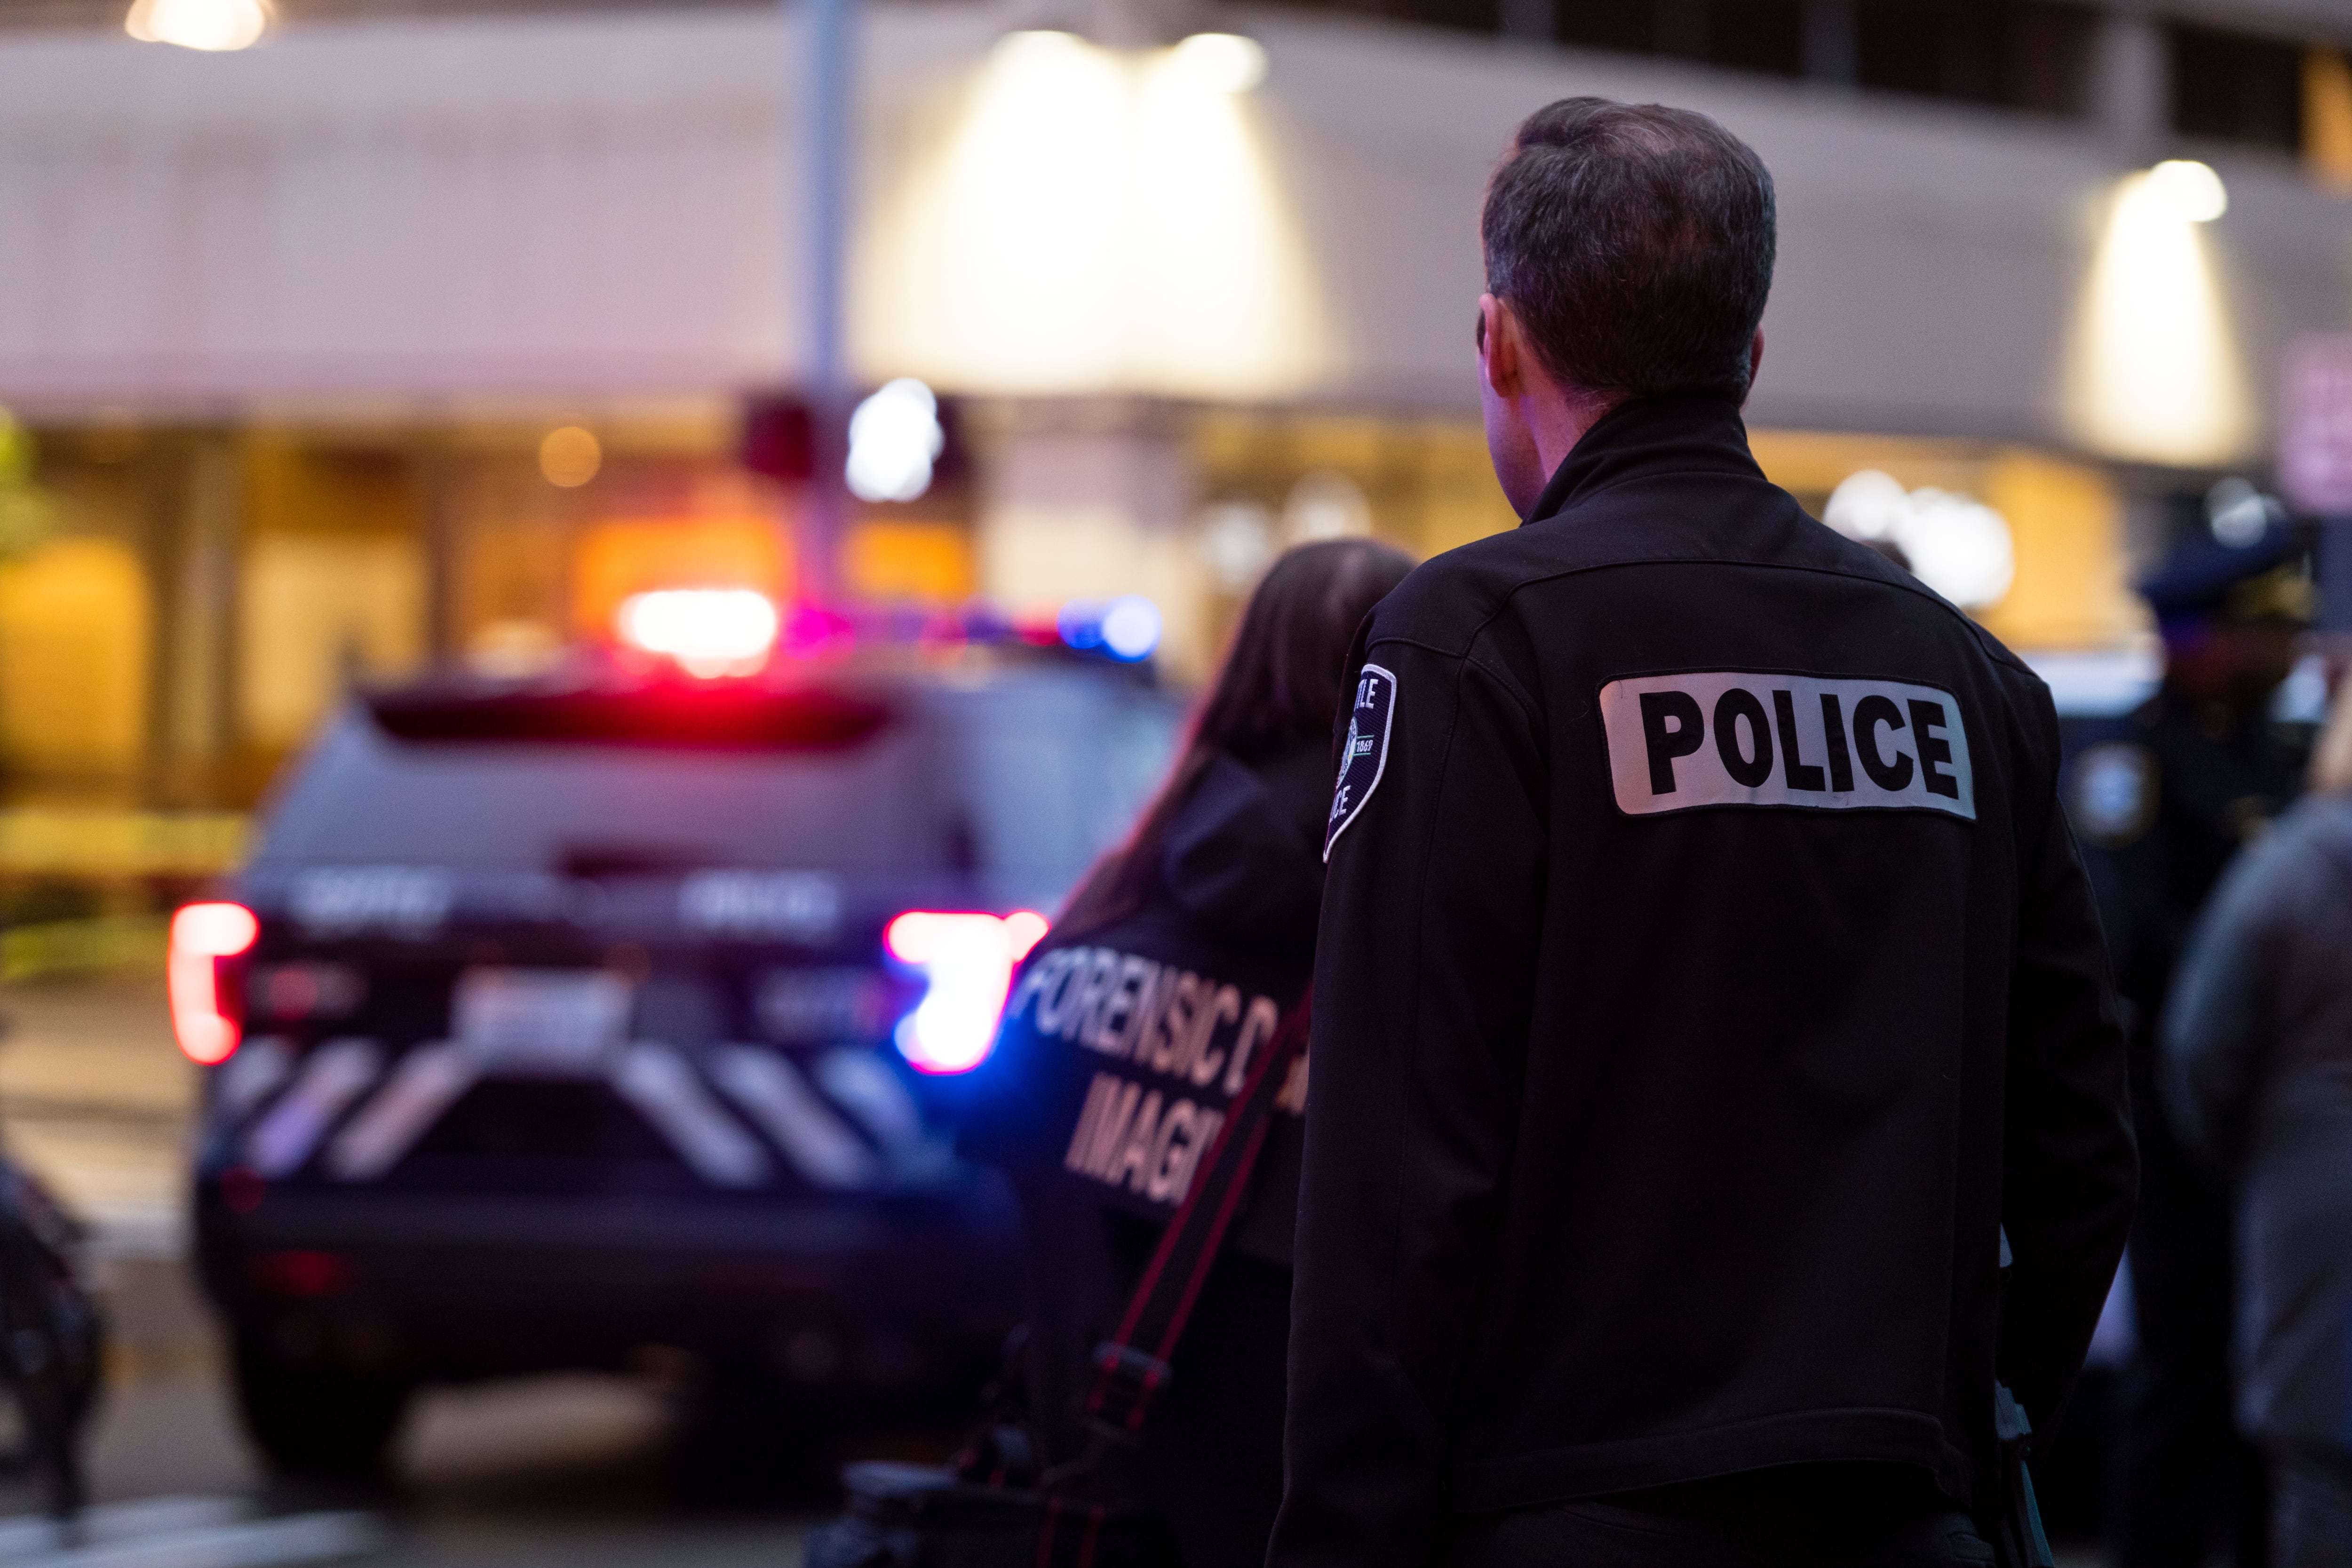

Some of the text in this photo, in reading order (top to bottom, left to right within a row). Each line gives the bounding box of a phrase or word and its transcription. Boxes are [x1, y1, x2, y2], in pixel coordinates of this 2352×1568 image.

[1357, 740, 1373, 752] 1869
[1639, 688, 1959, 800] POLICE
[1009, 945, 1240, 1087] FORENSIC
